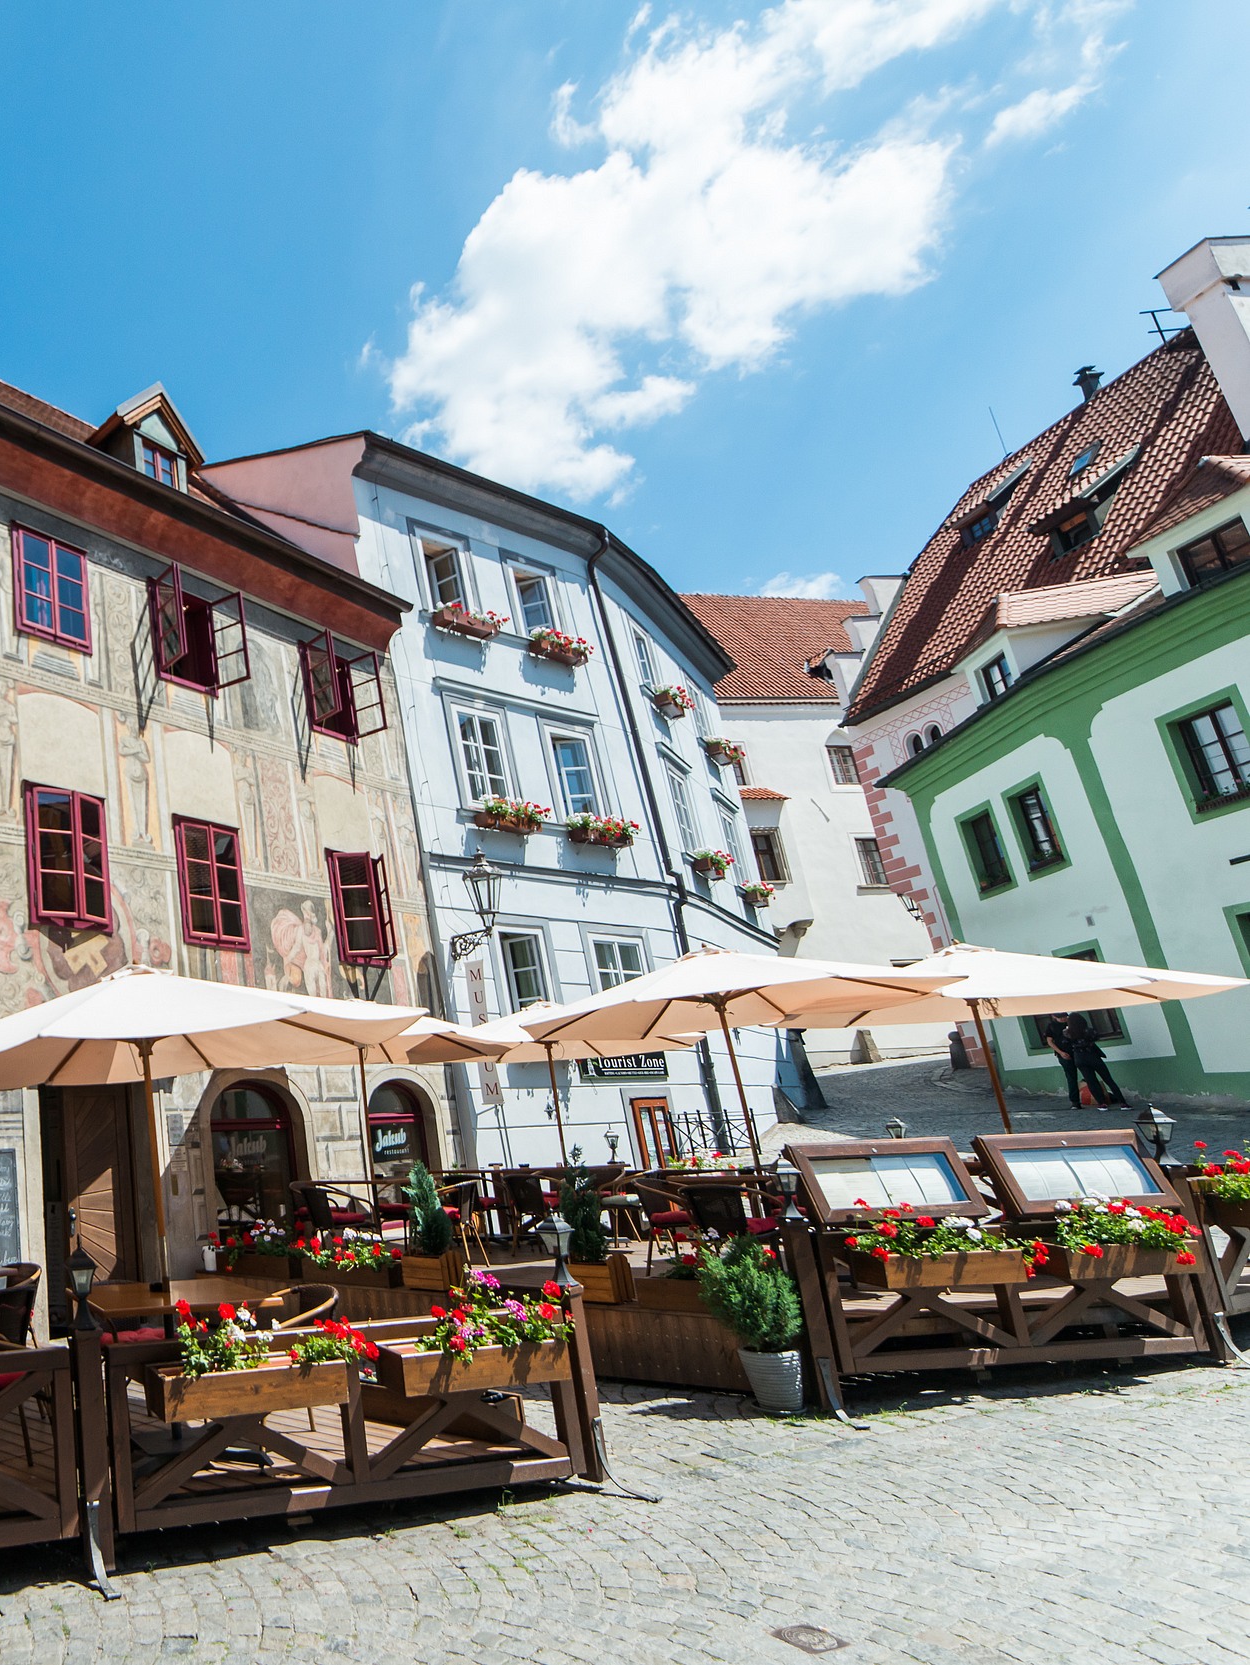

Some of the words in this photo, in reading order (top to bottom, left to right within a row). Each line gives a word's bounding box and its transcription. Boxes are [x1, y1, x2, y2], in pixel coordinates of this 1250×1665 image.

[469, 968, 500, 1096] MUSUM
[598, 1055, 637, 1069] Tourist
[638, 1054, 665, 1068] Zone
[227, 1135, 267, 1161] Jakub
[374, 1127, 407, 1152] Jakub
[383, 1147, 410, 1155] restaurant
